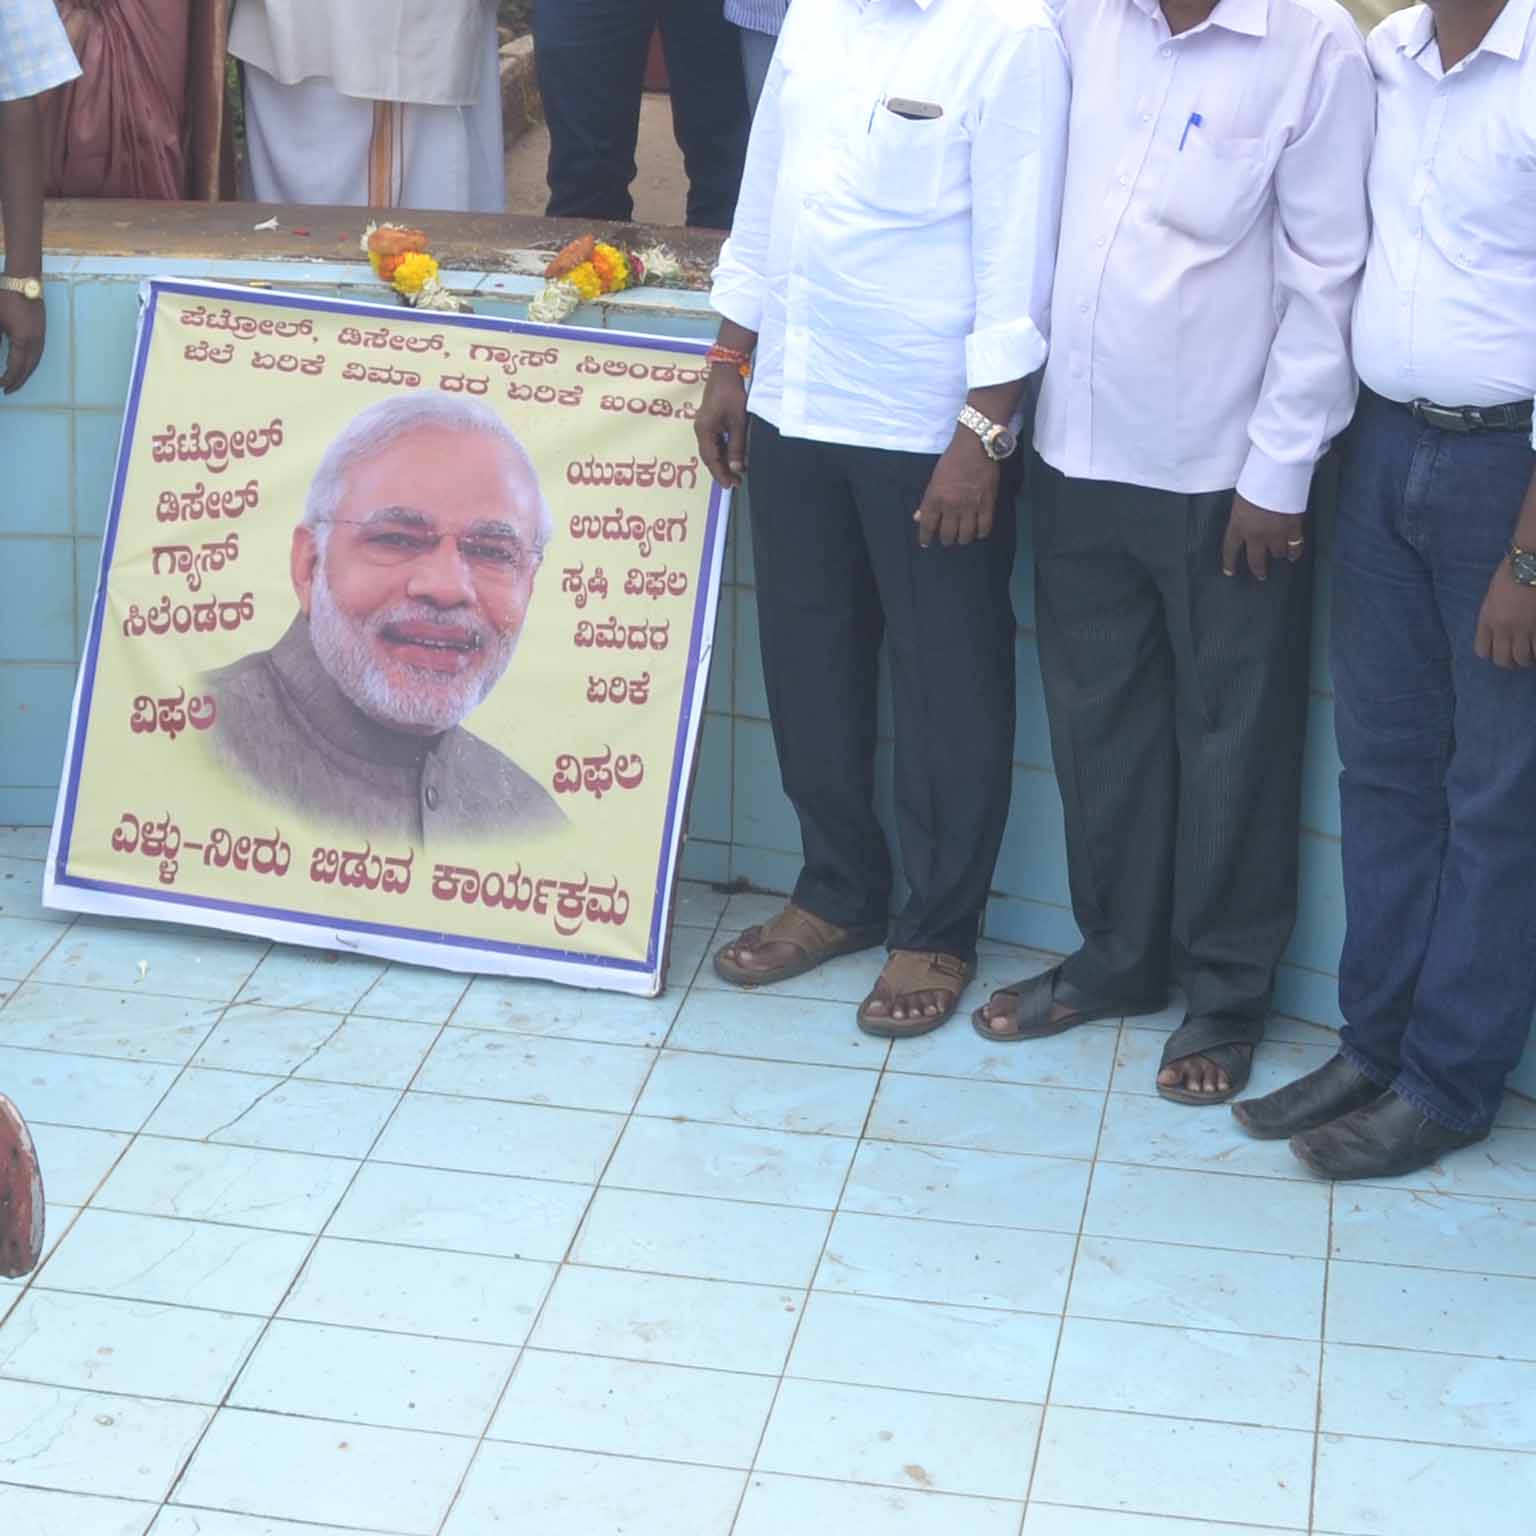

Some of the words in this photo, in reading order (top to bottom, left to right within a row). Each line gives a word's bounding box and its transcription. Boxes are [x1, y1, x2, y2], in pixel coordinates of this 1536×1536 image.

[183, 341, 235, 365] ಬೆಲೆ
[251, 351, 326, 376] ಏರಿಕೆ
[341, 362, 421, 388] ವಿಮಾ
[439, 373, 490, 396] ದರ
[507, 381, 584, 406] ಏರಿಕೆ
[469, 343, 559, 376] ಗ್ಯಾಸ್
[151, 418, 284, 474] ಪೆಟ್ರೋಲ್
[566, 455, 699, 489] ಯುವಕರಿಗೆ
[156, 479, 259, 523] ಡಿಸೇಲ್
[569, 507, 688, 558] ಉದ್ಯೋಗ
[151, 532, 239, 593] ಗ್ಯಾಸ್
[623, 565, 688, 601] ವಿಫಲ
[122, 589, 255, 638] ಸಿಲೆಂಡರ್
[573, 615, 670, 651] ವಿಮೆದರ
[130, 683, 216, 739] ವಿಫಲ
[586, 671, 651, 705] ಏರಿಕೆ
[552, 745, 644, 798] ವಿಫಲ
[110, 812, 292, 885] ಎಳ್ಳು-ನೀರು
[309, 842, 415, 895] ಬಿಡುವ
[431, 863, 630, 936] ಕಾರ್ಯಕ್ರಮ
